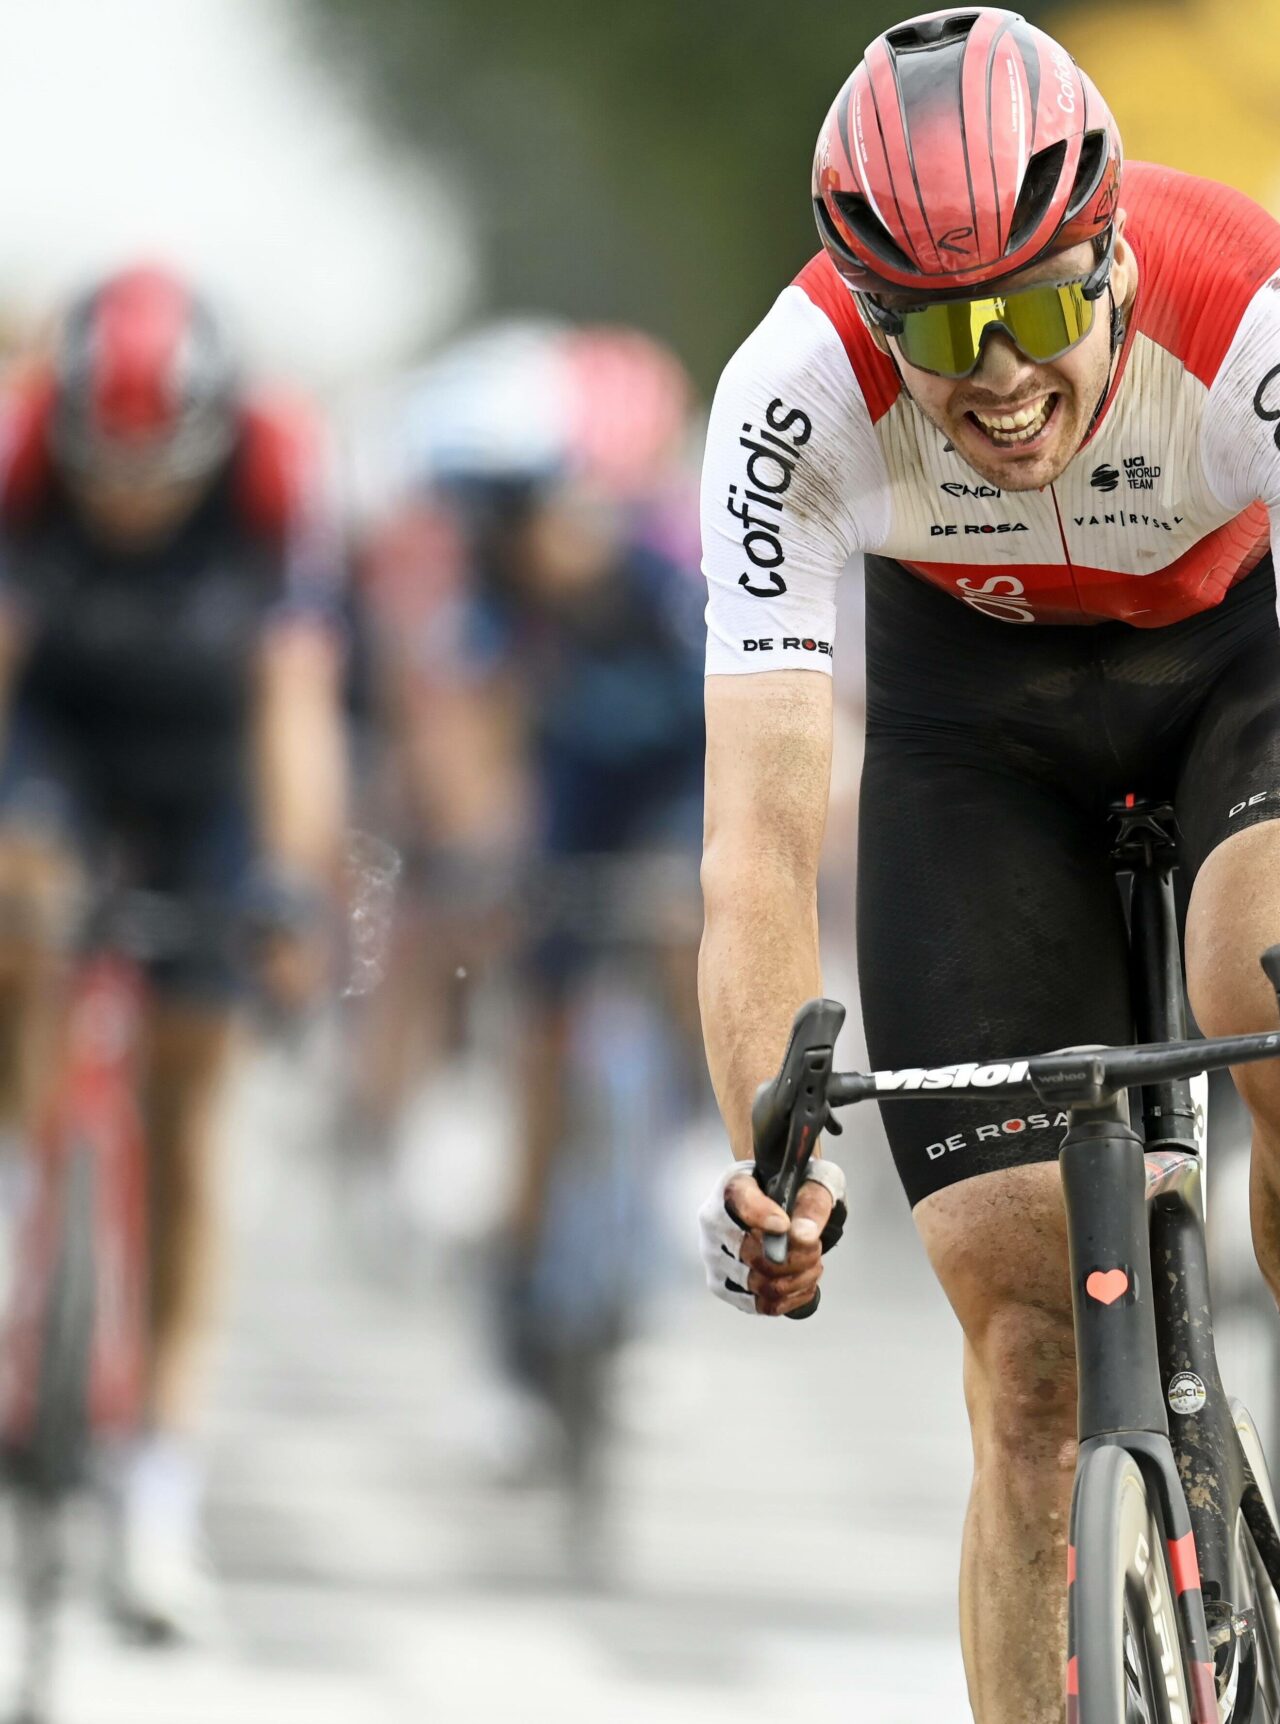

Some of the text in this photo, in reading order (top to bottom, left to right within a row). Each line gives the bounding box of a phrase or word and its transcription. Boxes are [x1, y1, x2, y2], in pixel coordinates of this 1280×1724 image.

[1125, 466, 1161, 478] WORLD
[1127, 478, 1153, 490] TEAM
[930, 522, 1029, 537] DE ROSA
[743, 638, 773, 651] DE
[1228, 791, 1267, 818] DE
[1038, 1072, 1087, 1083] wahoo
[925, 1134, 966, 1160] DE
